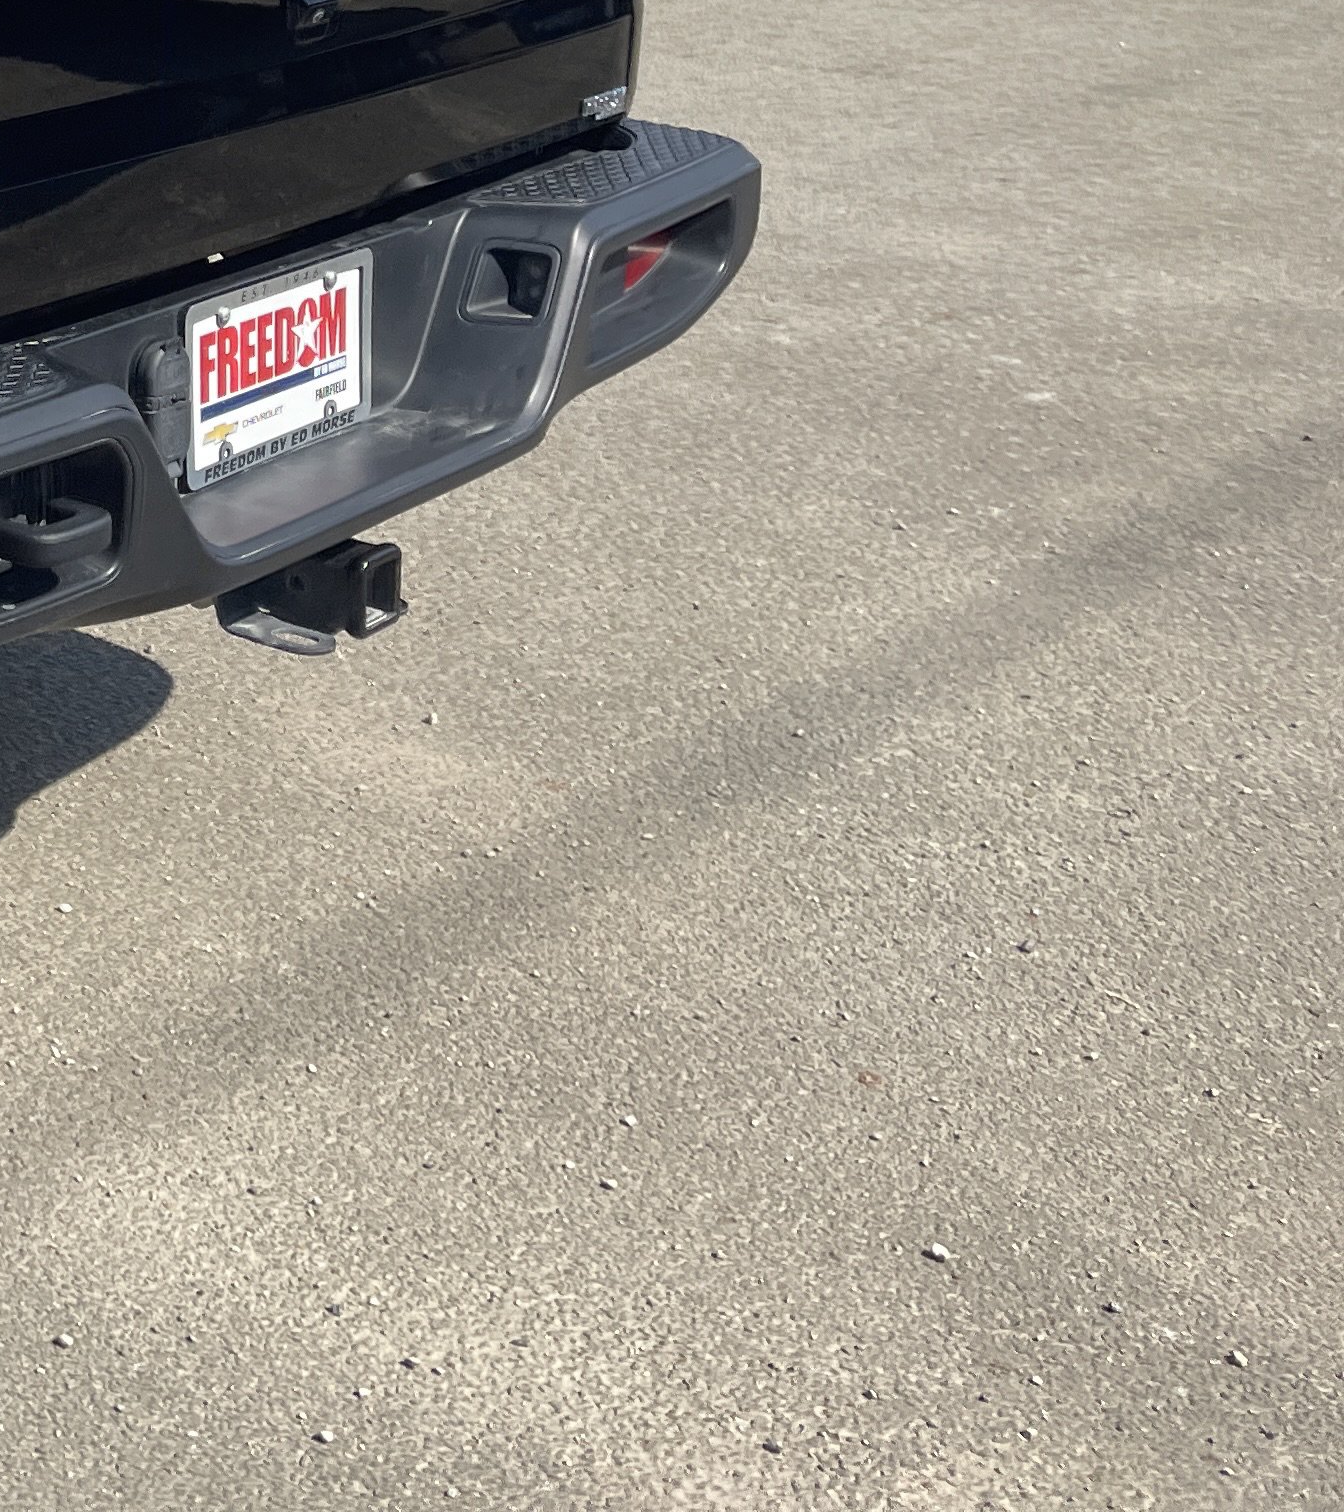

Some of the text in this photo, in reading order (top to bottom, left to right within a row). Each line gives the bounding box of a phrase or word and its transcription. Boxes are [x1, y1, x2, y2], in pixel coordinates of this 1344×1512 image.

[315, 379, 347, 400] FAIRFIELD
[242, 405, 284, 428] CHEVROLET
[204, 409, 355, 483] FREEDOM BY ED MORSE
